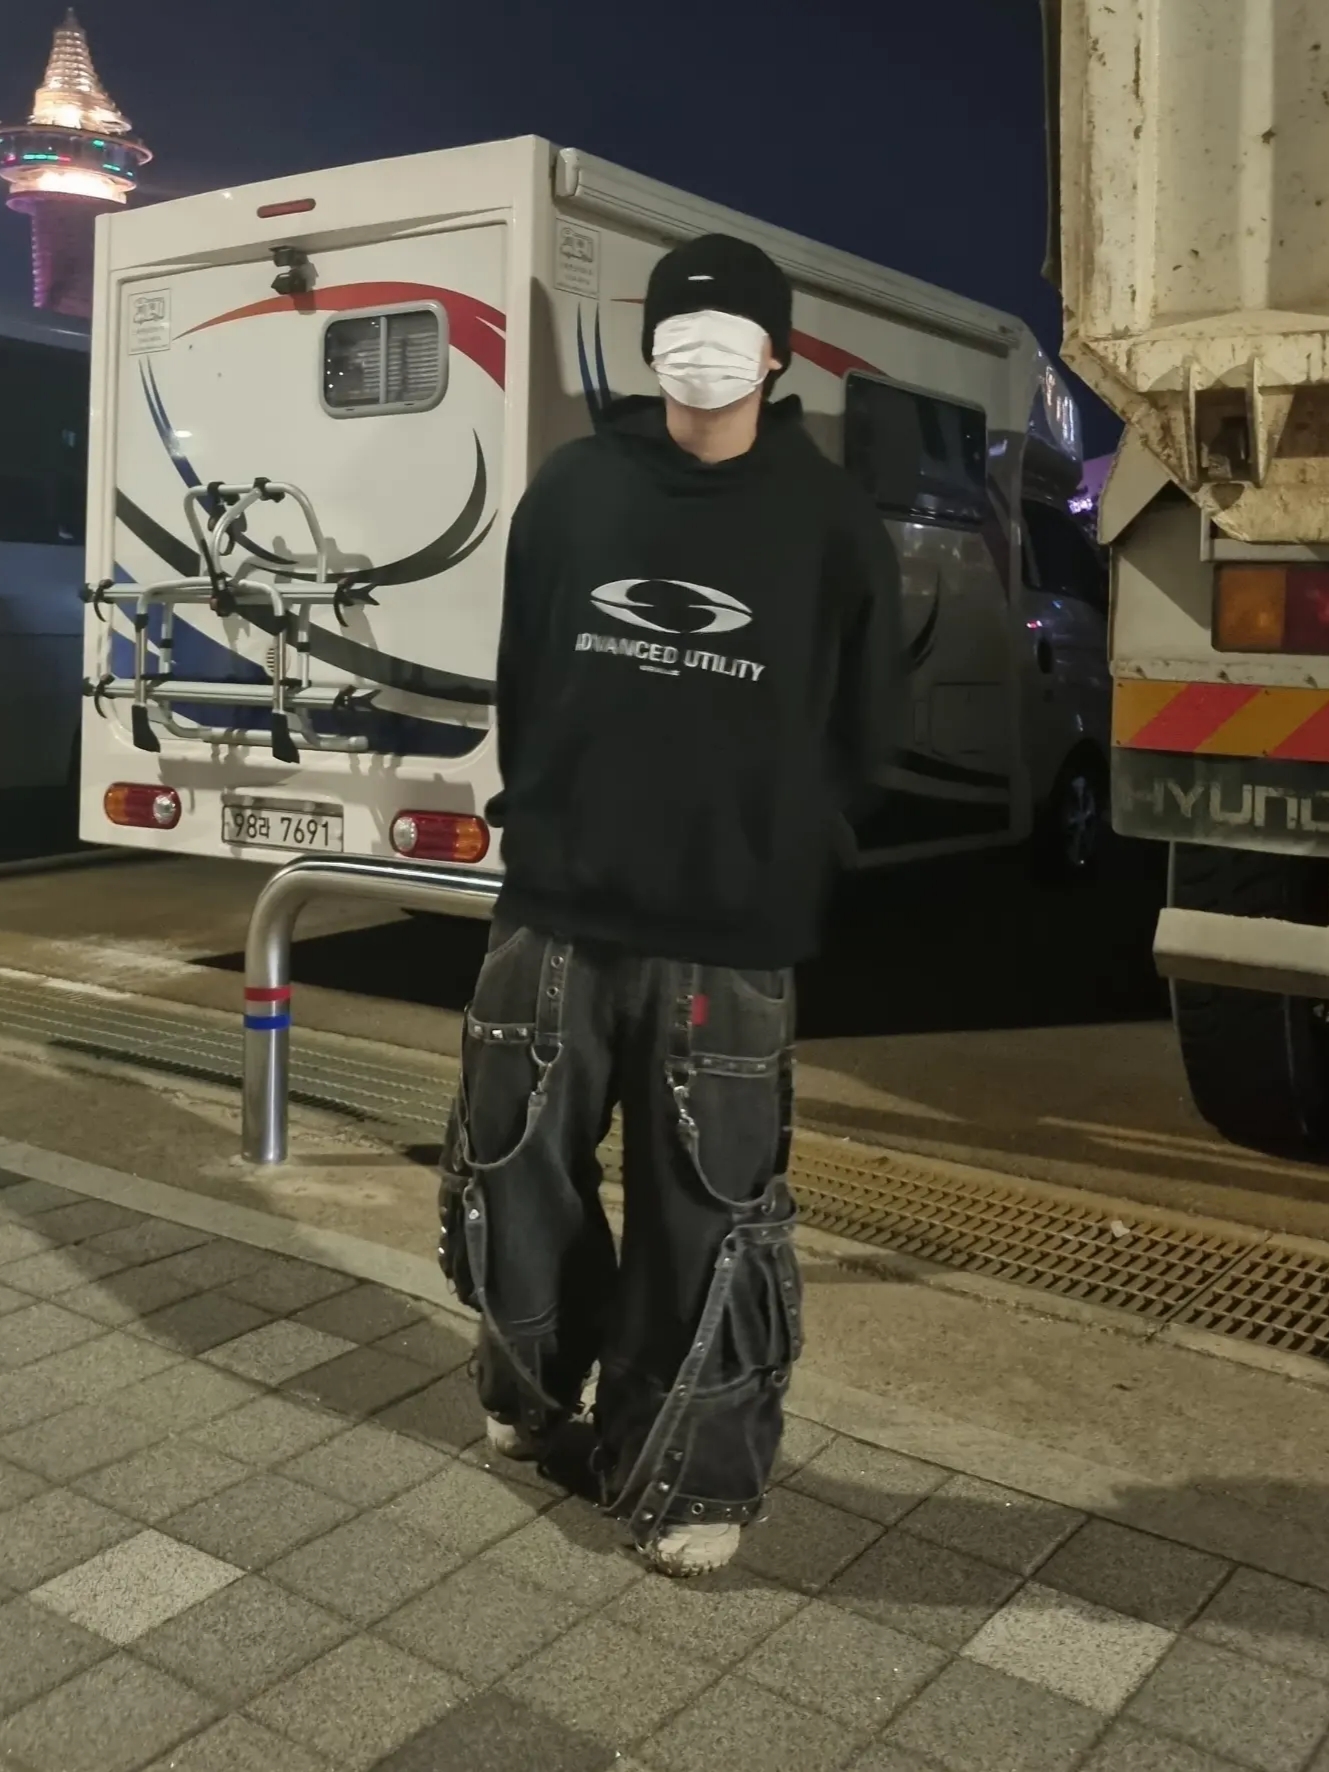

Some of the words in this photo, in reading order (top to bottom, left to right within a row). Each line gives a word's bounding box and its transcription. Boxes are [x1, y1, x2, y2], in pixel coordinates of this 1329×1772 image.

[684, 650, 766, 682] UTILITY
[233, 812, 270, 839] 98라
[280, 816, 329, 846] 7691
